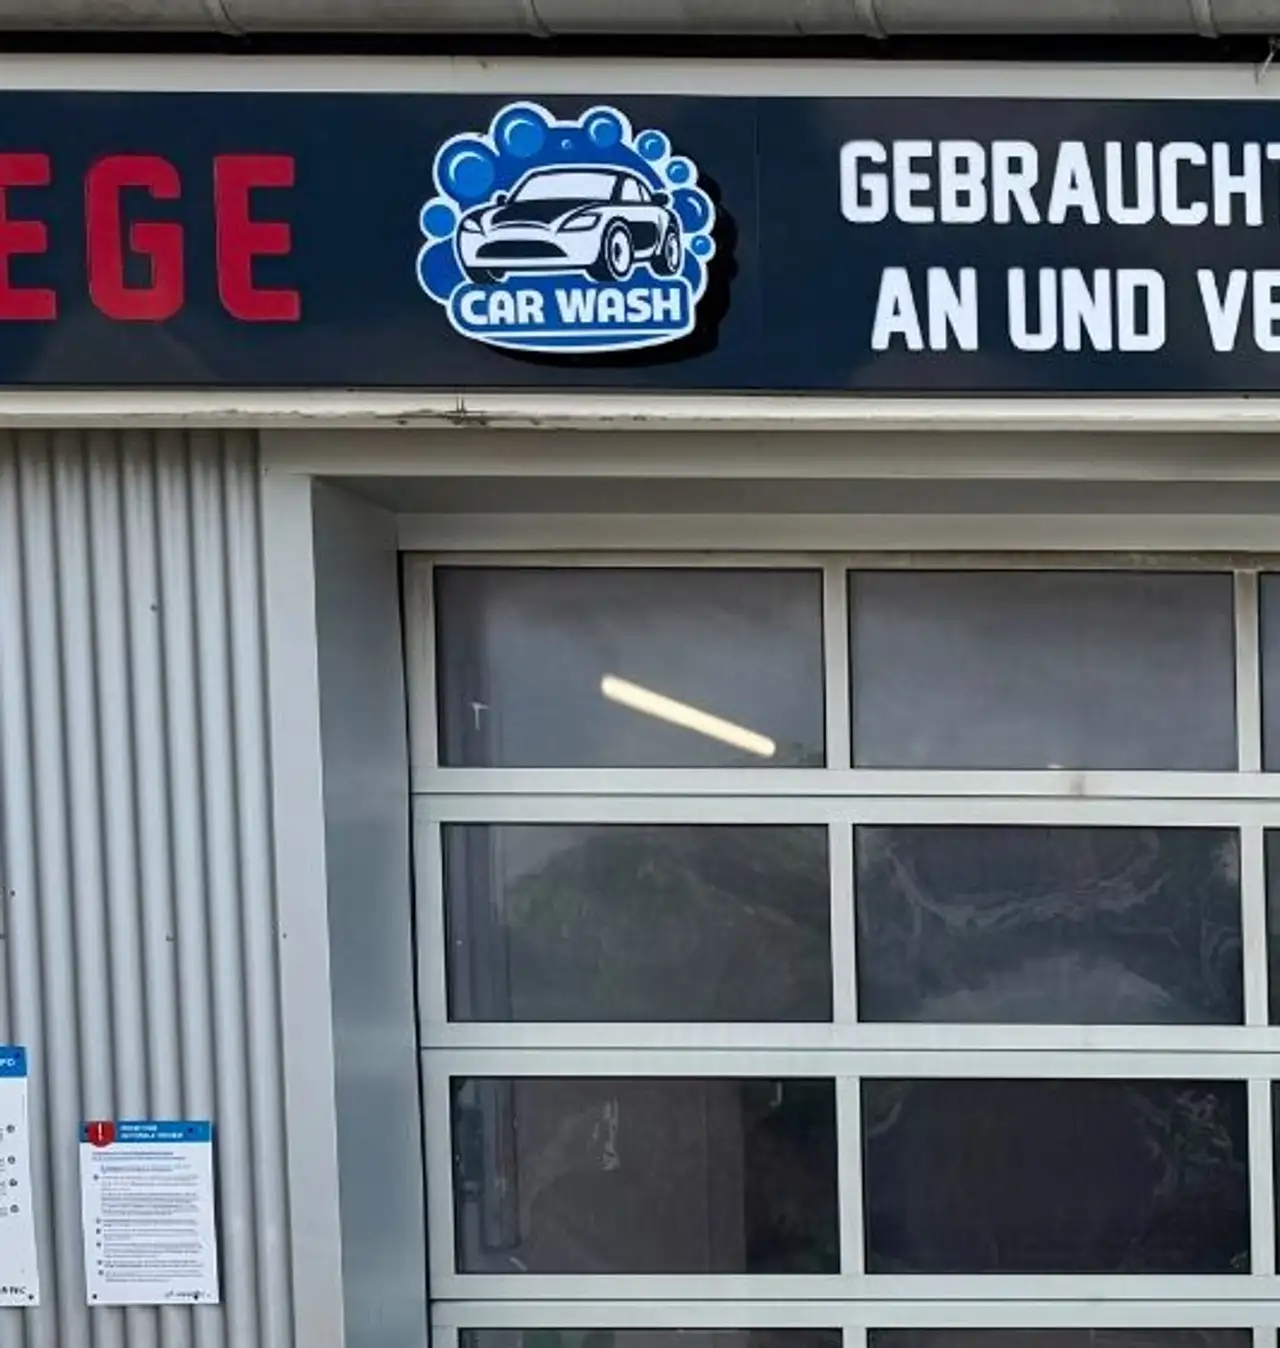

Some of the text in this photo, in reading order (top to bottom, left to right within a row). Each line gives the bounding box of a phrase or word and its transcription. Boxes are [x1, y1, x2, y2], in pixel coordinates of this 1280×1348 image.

[0, 152, 301, 322] EGE
[460, 288, 681, 325] CAR WASH
[871, 267, 978, 351] AN
[1008, 268, 1166, 352] UND
